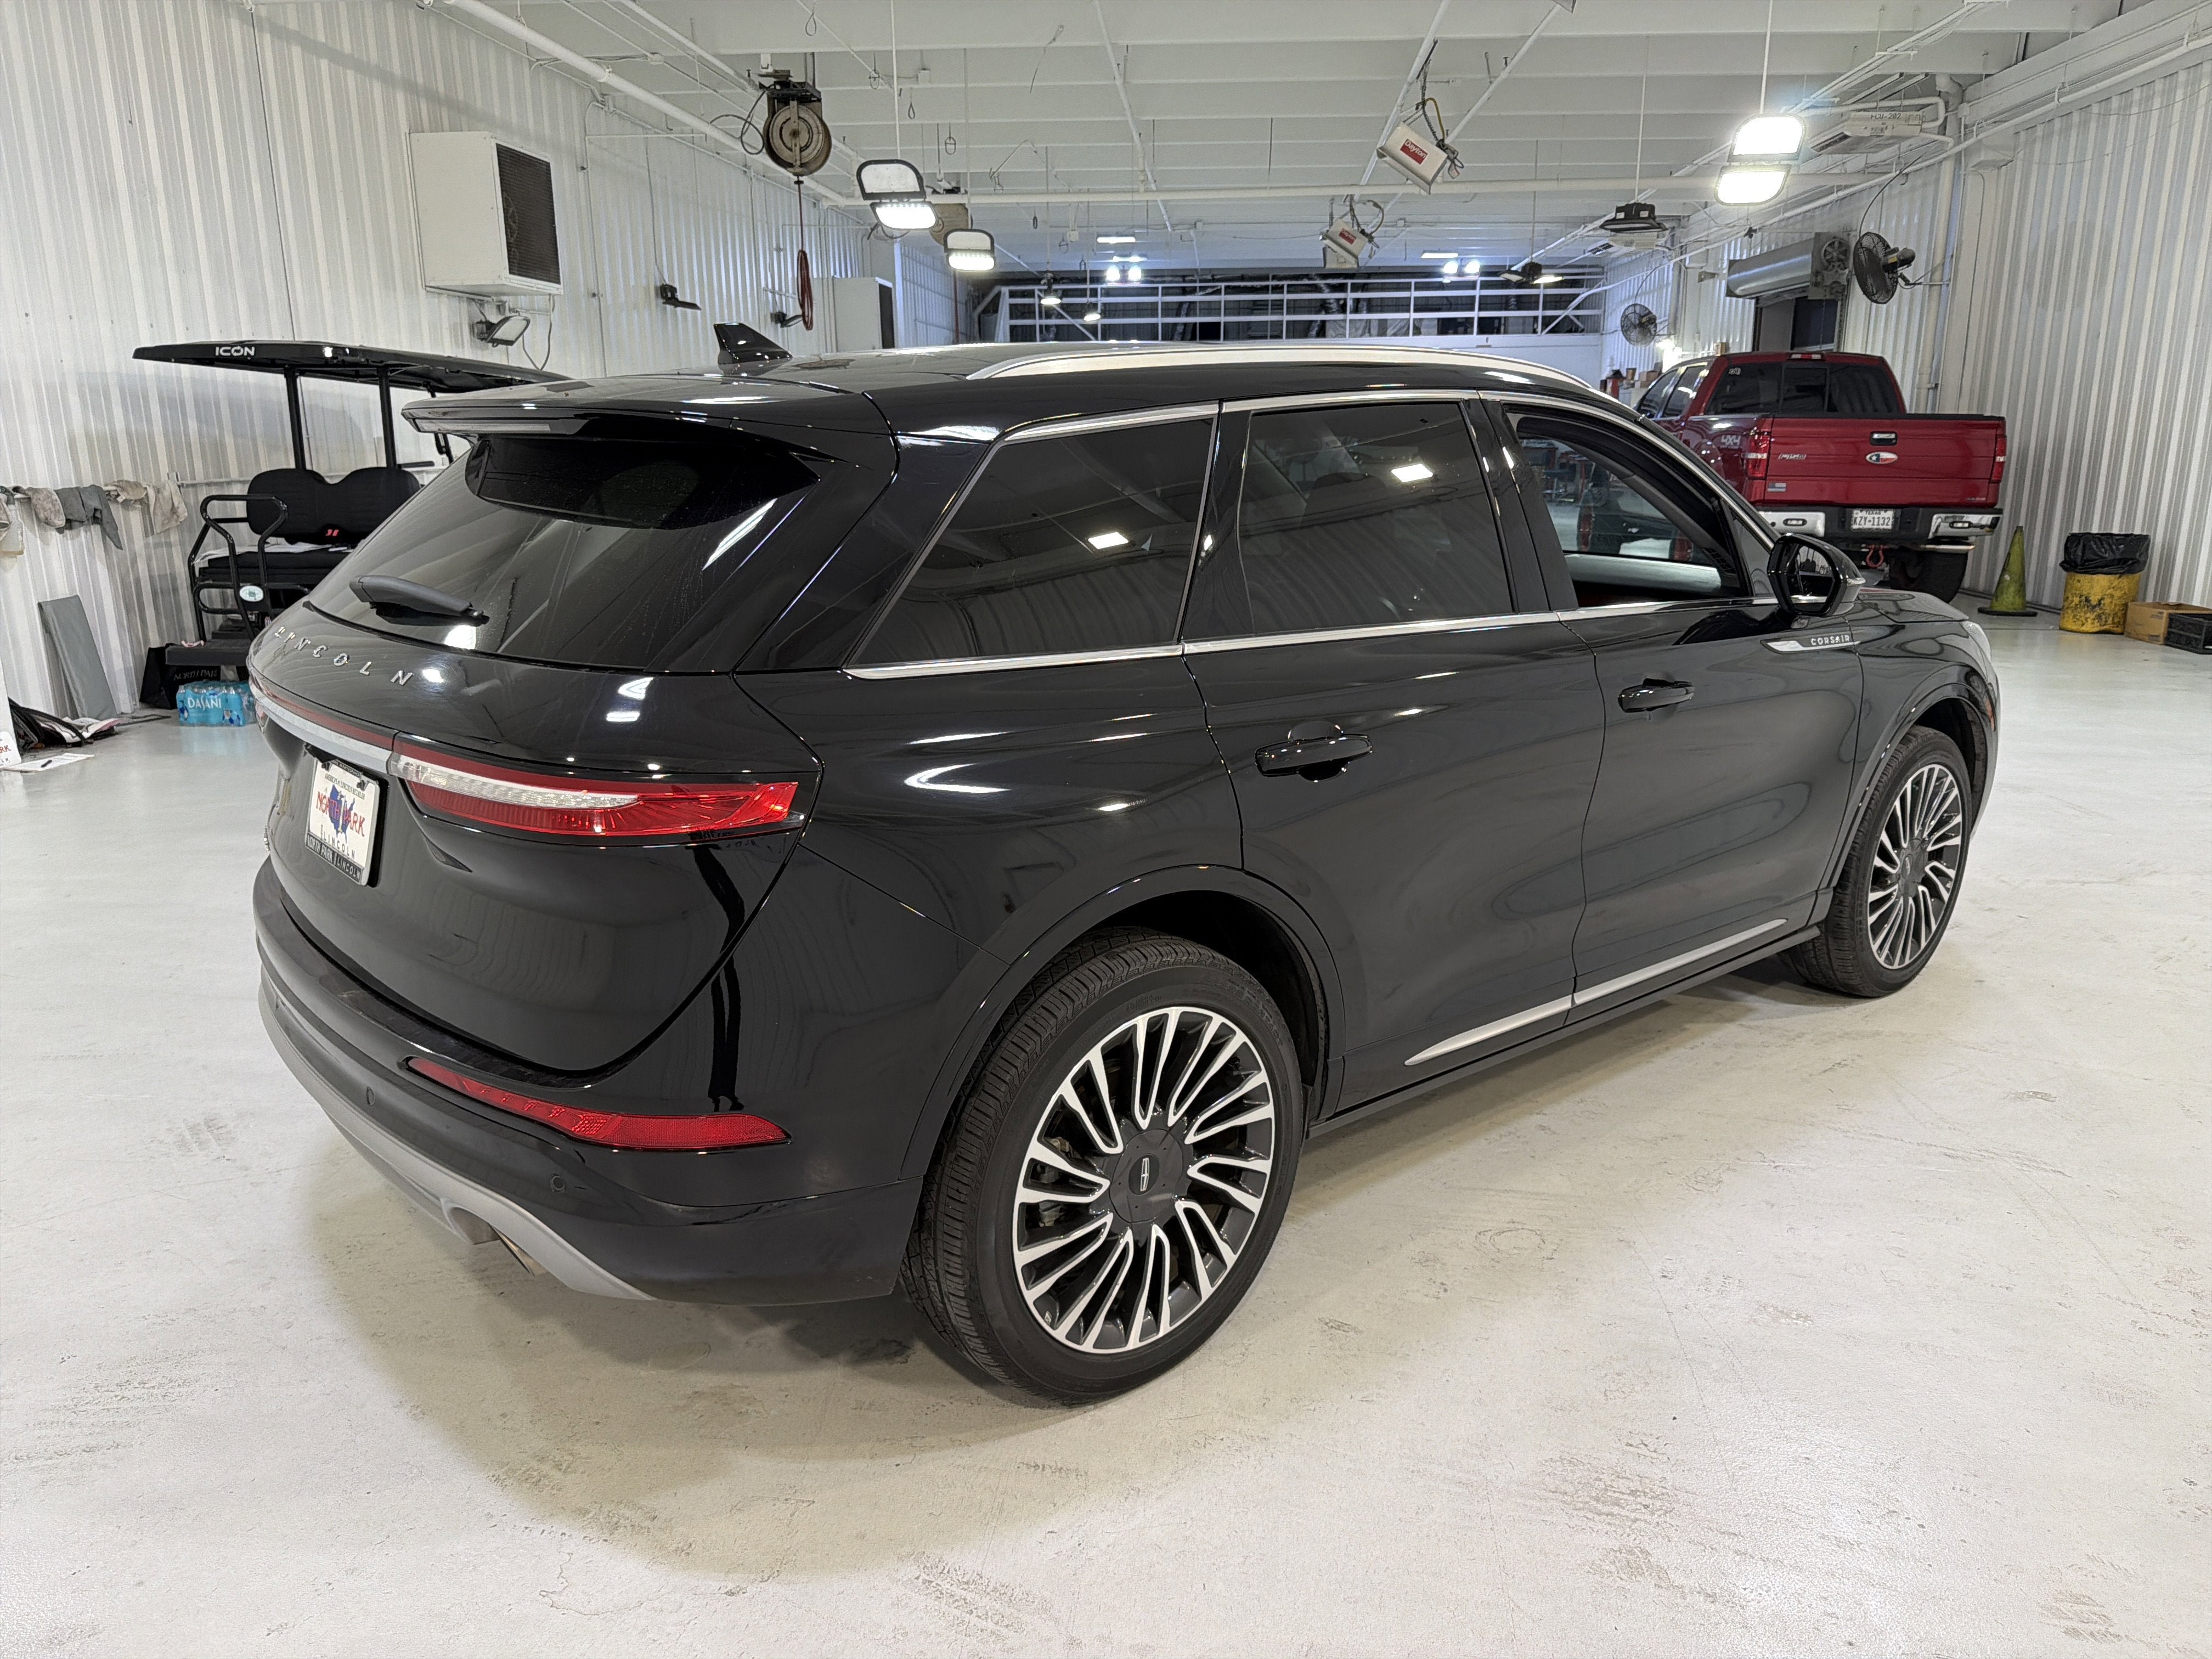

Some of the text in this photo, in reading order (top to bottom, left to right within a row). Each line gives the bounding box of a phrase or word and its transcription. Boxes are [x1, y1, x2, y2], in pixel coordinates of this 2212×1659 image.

[1404, 140, 1427, 159] Dayton
[215, 346, 255, 356] ICON
[1810, 635, 1850, 646] CORSAIR
[275, 627, 414, 686] LINCOLN
[187, 695, 222, 711] DASANI
[316, 791, 365, 837] NORTH PARK
[307, 834, 362, 880] NORTH PARK LINCOLN
[324, 831, 356, 860] LINCOLN
